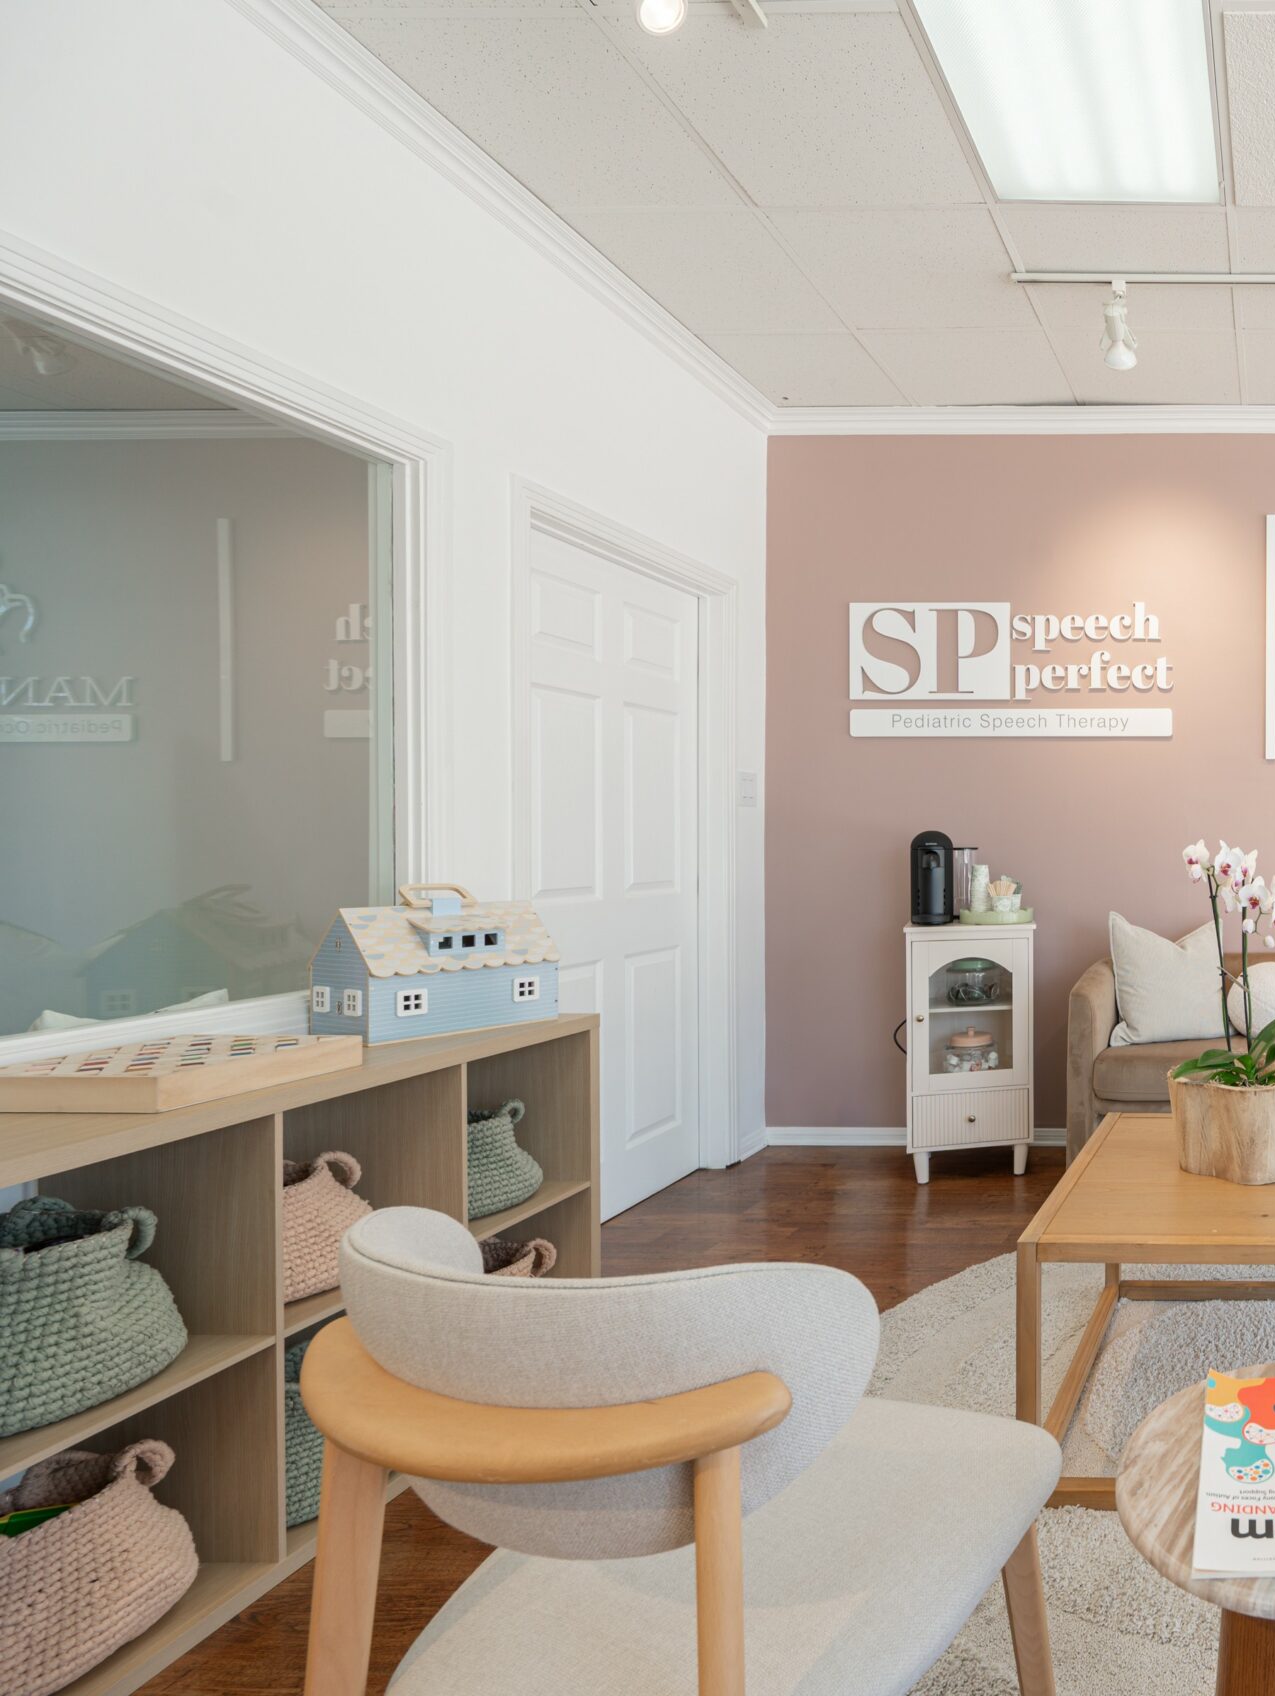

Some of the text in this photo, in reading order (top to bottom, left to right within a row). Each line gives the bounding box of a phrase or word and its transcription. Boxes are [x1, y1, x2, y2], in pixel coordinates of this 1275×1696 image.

[1011, 601, 1161, 651] speech
[860, 607, 1000, 696] SP
[1013, 650, 1174, 700] perfect
[891, 713, 1130, 733] Pediatric Speech Therapy
